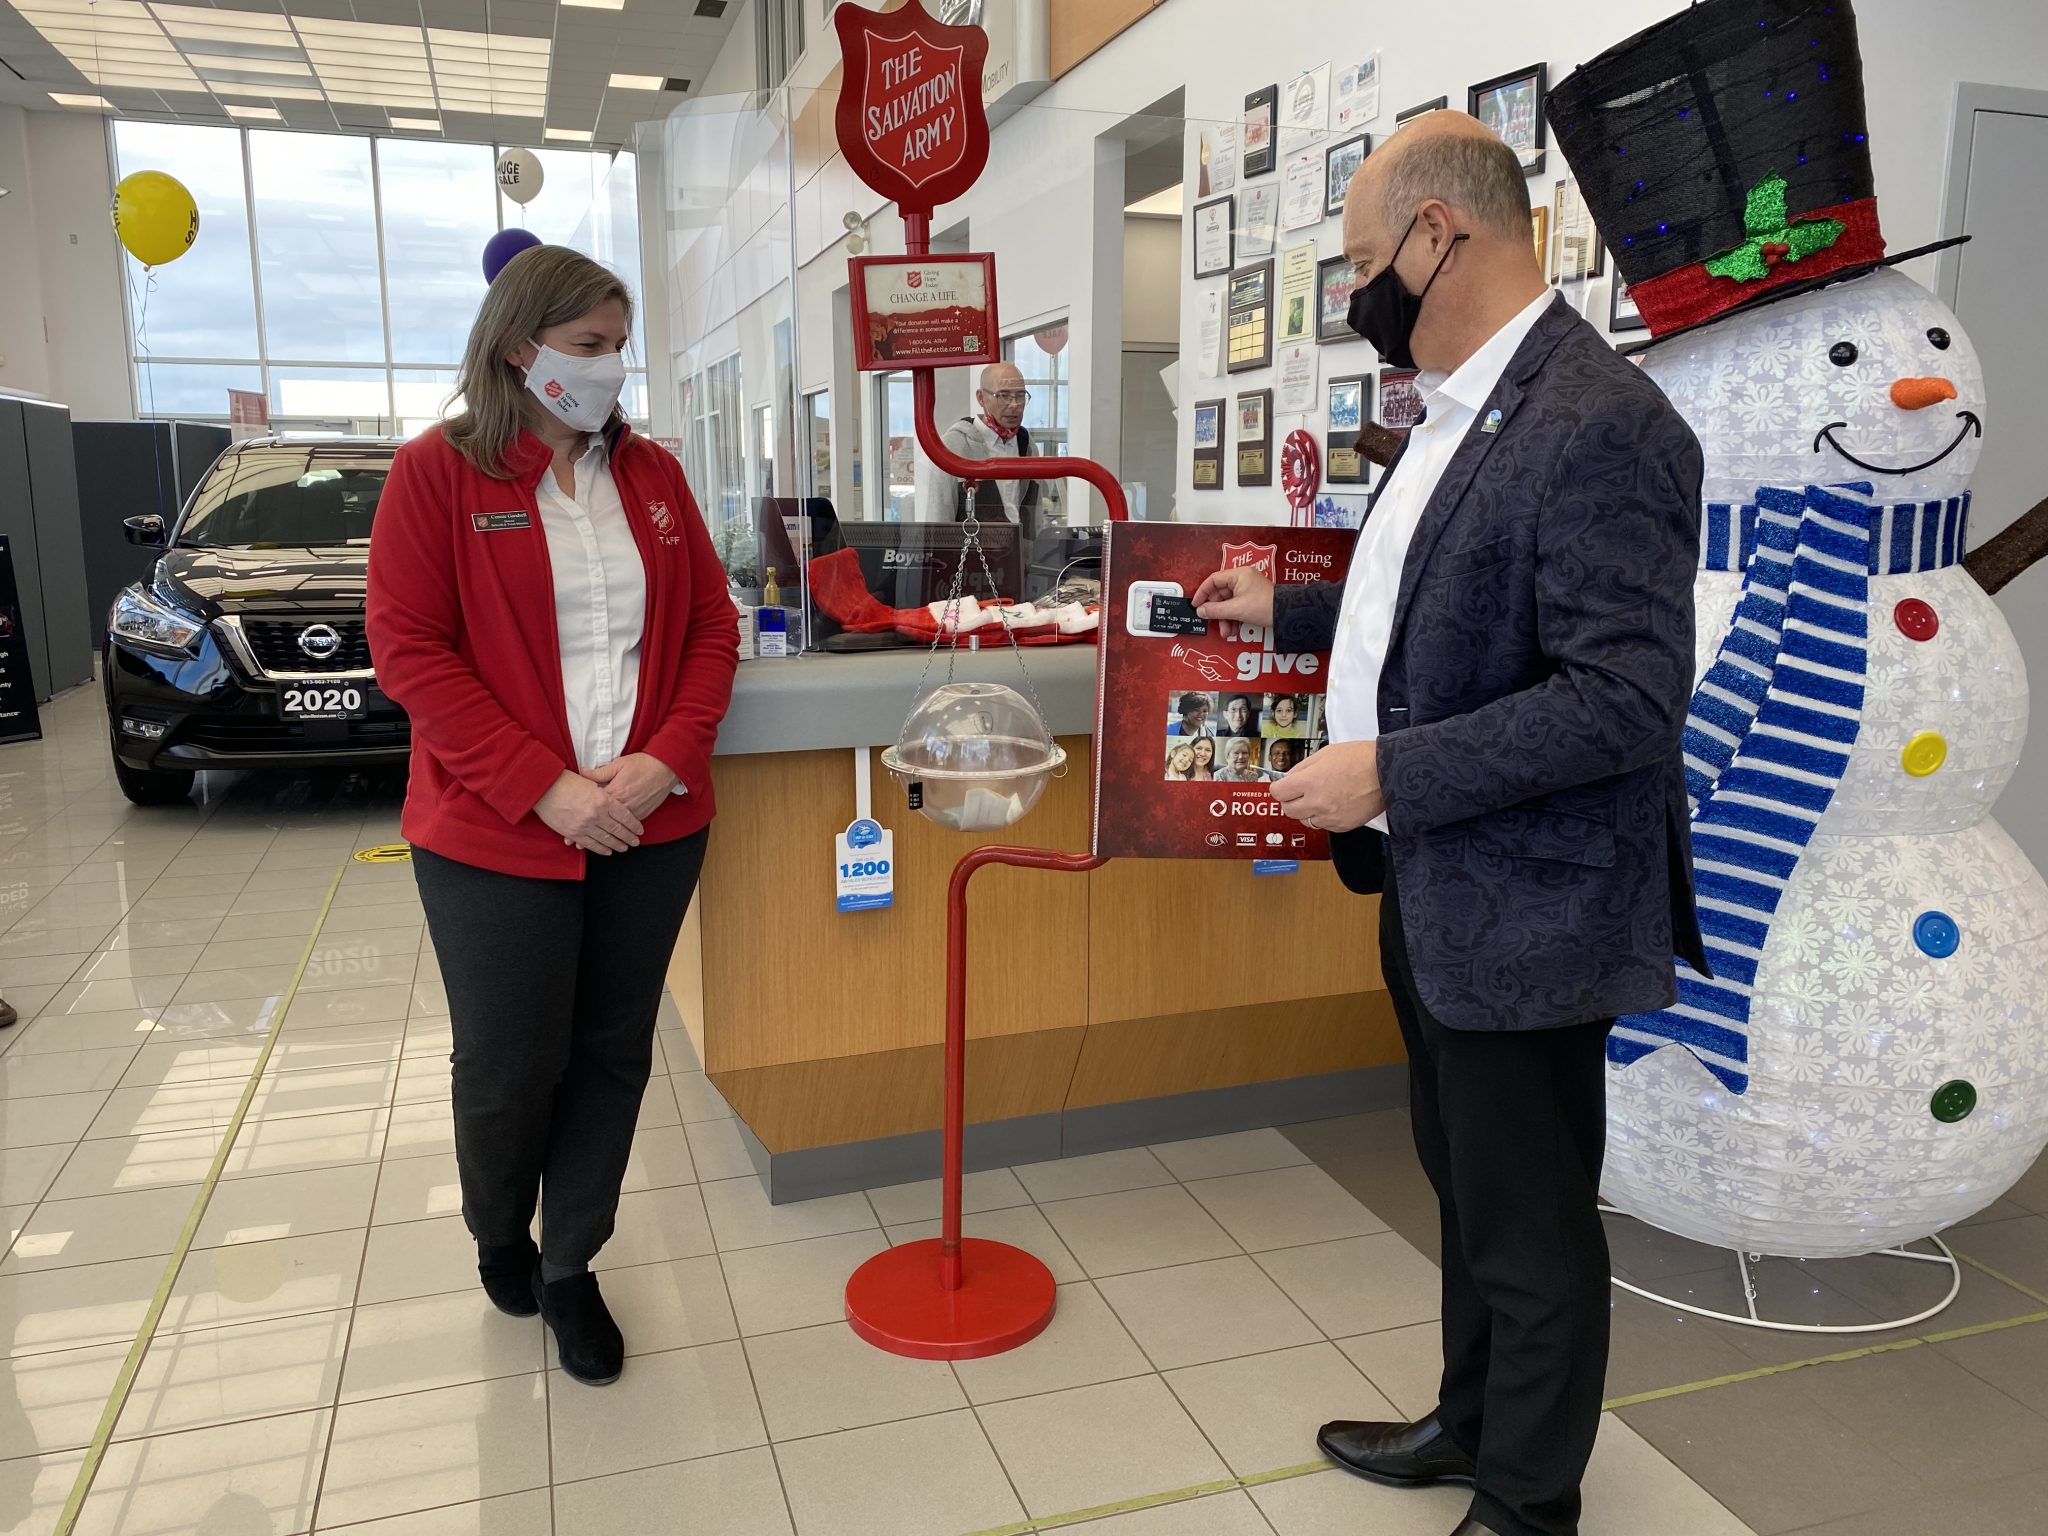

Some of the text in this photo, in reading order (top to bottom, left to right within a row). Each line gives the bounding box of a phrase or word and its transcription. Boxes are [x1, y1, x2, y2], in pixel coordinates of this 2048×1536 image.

[881, 47, 922, 90] THE
[867, 63, 956, 141] SALVATION
[902, 106, 956, 167] ARMY
[890, 293, 928, 304] CHANGE
[930, 294, 937, 302] A
[883, 548, 934, 566] Boyer
[1231, 551, 1254, 569] THE
[1285, 550, 1332, 568] Giving
[1284, 568, 1321, 585] Hope
[1236, 651, 1319, 681] give
[284, 689, 361, 712] 2020
[1231, 801, 1287, 817] ROGE
[840, 860, 890, 878] 1,200
